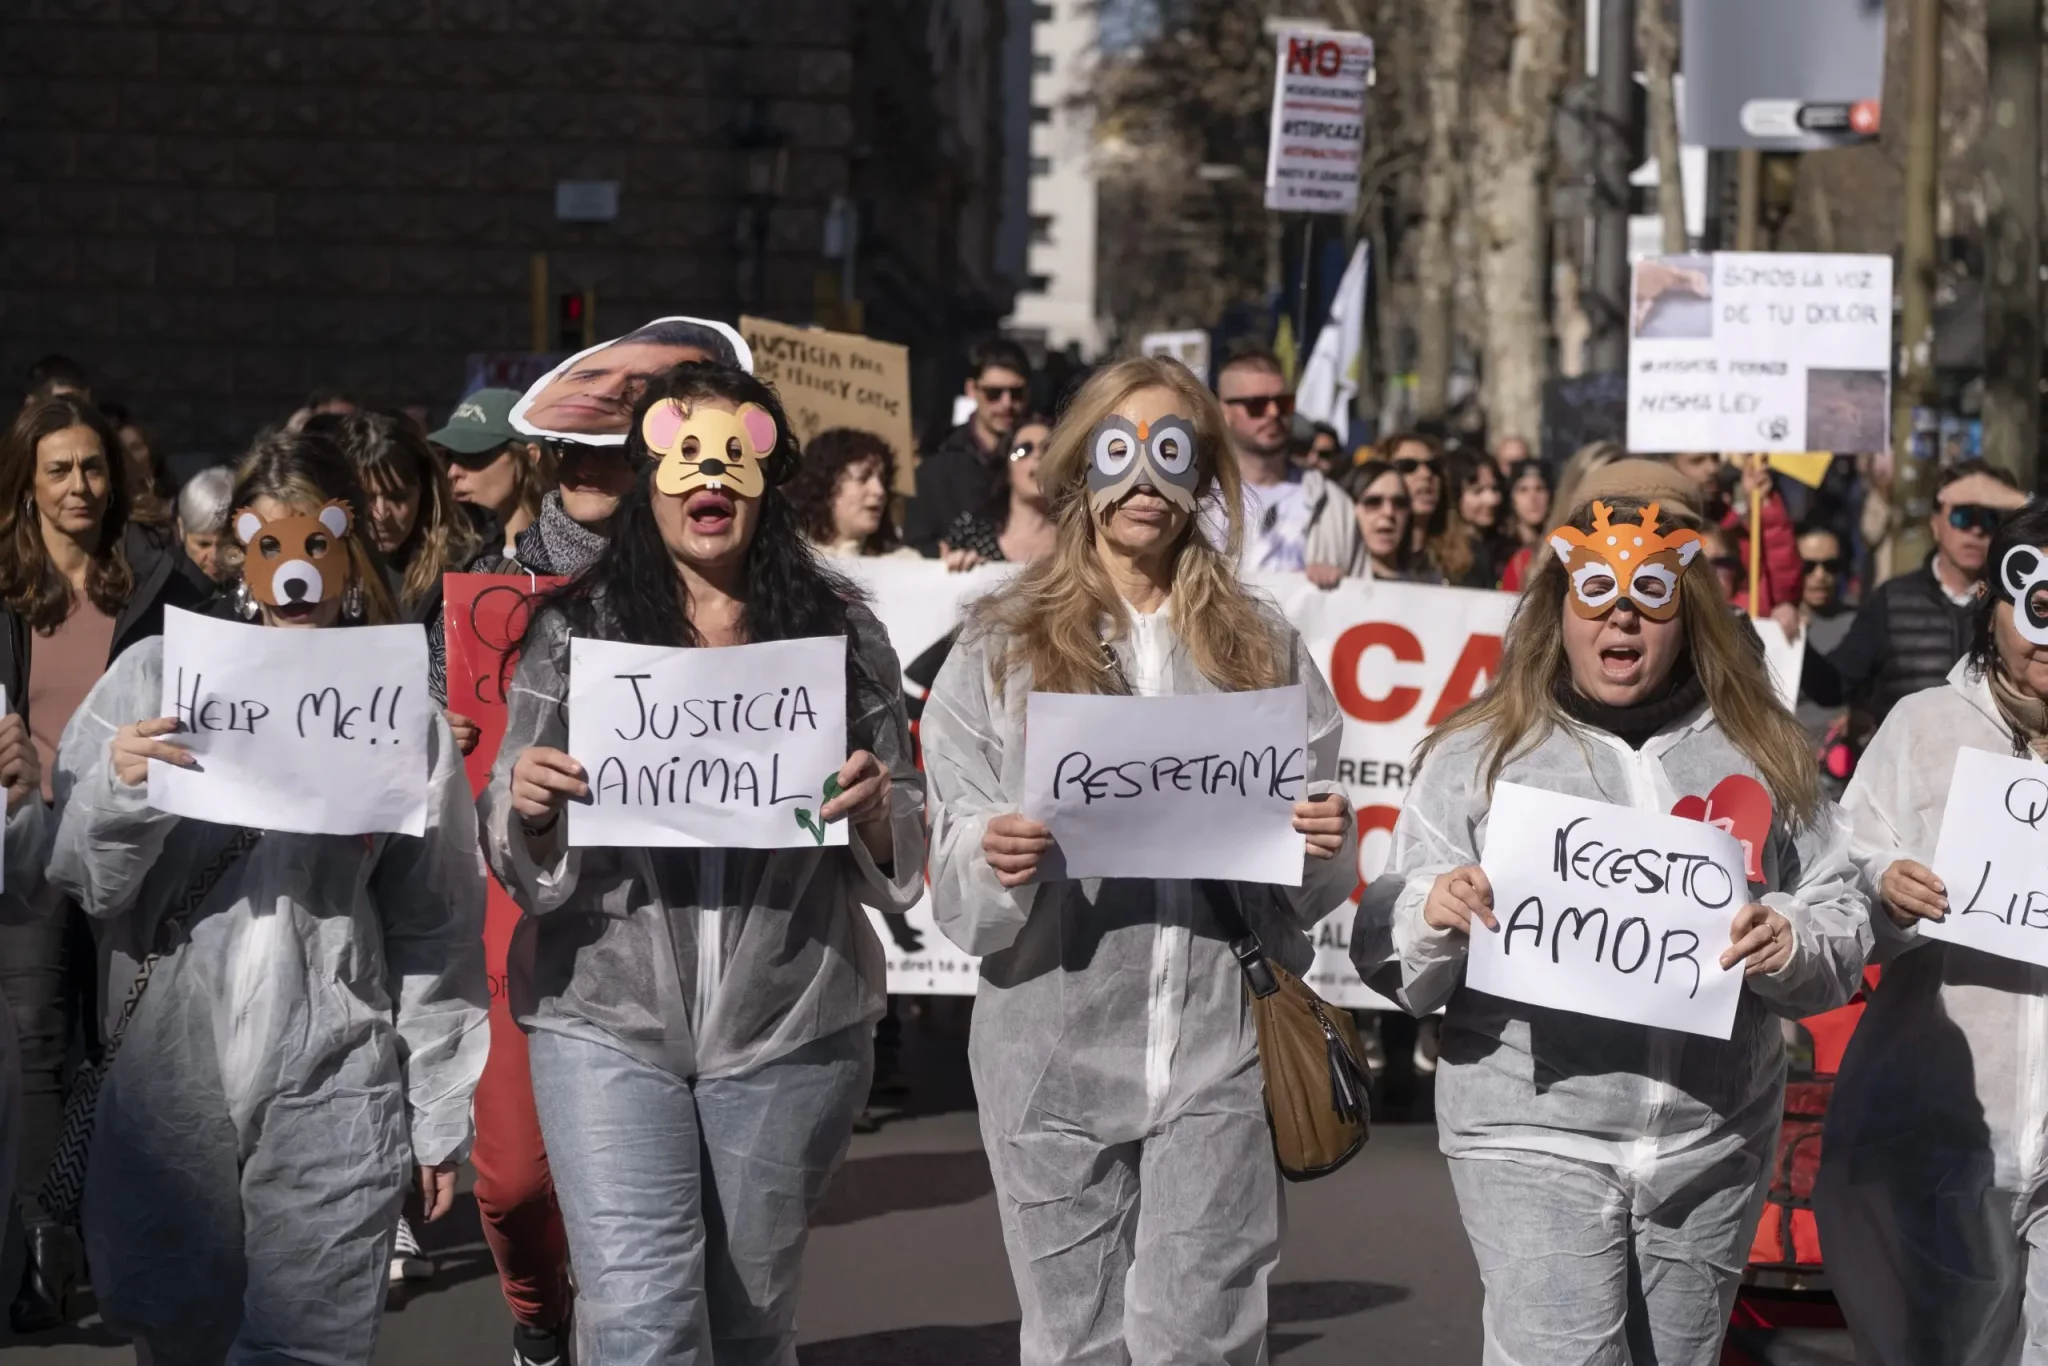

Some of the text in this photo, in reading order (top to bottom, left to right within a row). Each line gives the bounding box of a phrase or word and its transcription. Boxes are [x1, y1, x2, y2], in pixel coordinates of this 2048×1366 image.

[1287, 37, 1342, 78] NO
[1722, 267, 1873, 289] SOMOS LA VOZ
[1723, 303, 1878, 325] DE TU DOLOR
[1719, 391, 1762, 414] LEY
[175, 666, 403, 745] HELP ME!!
[1053, 745, 1305, 805] RESPETAME
[1554, 817, 1732, 909] NECESITO
[1504, 896, 1700, 999] AMOR
